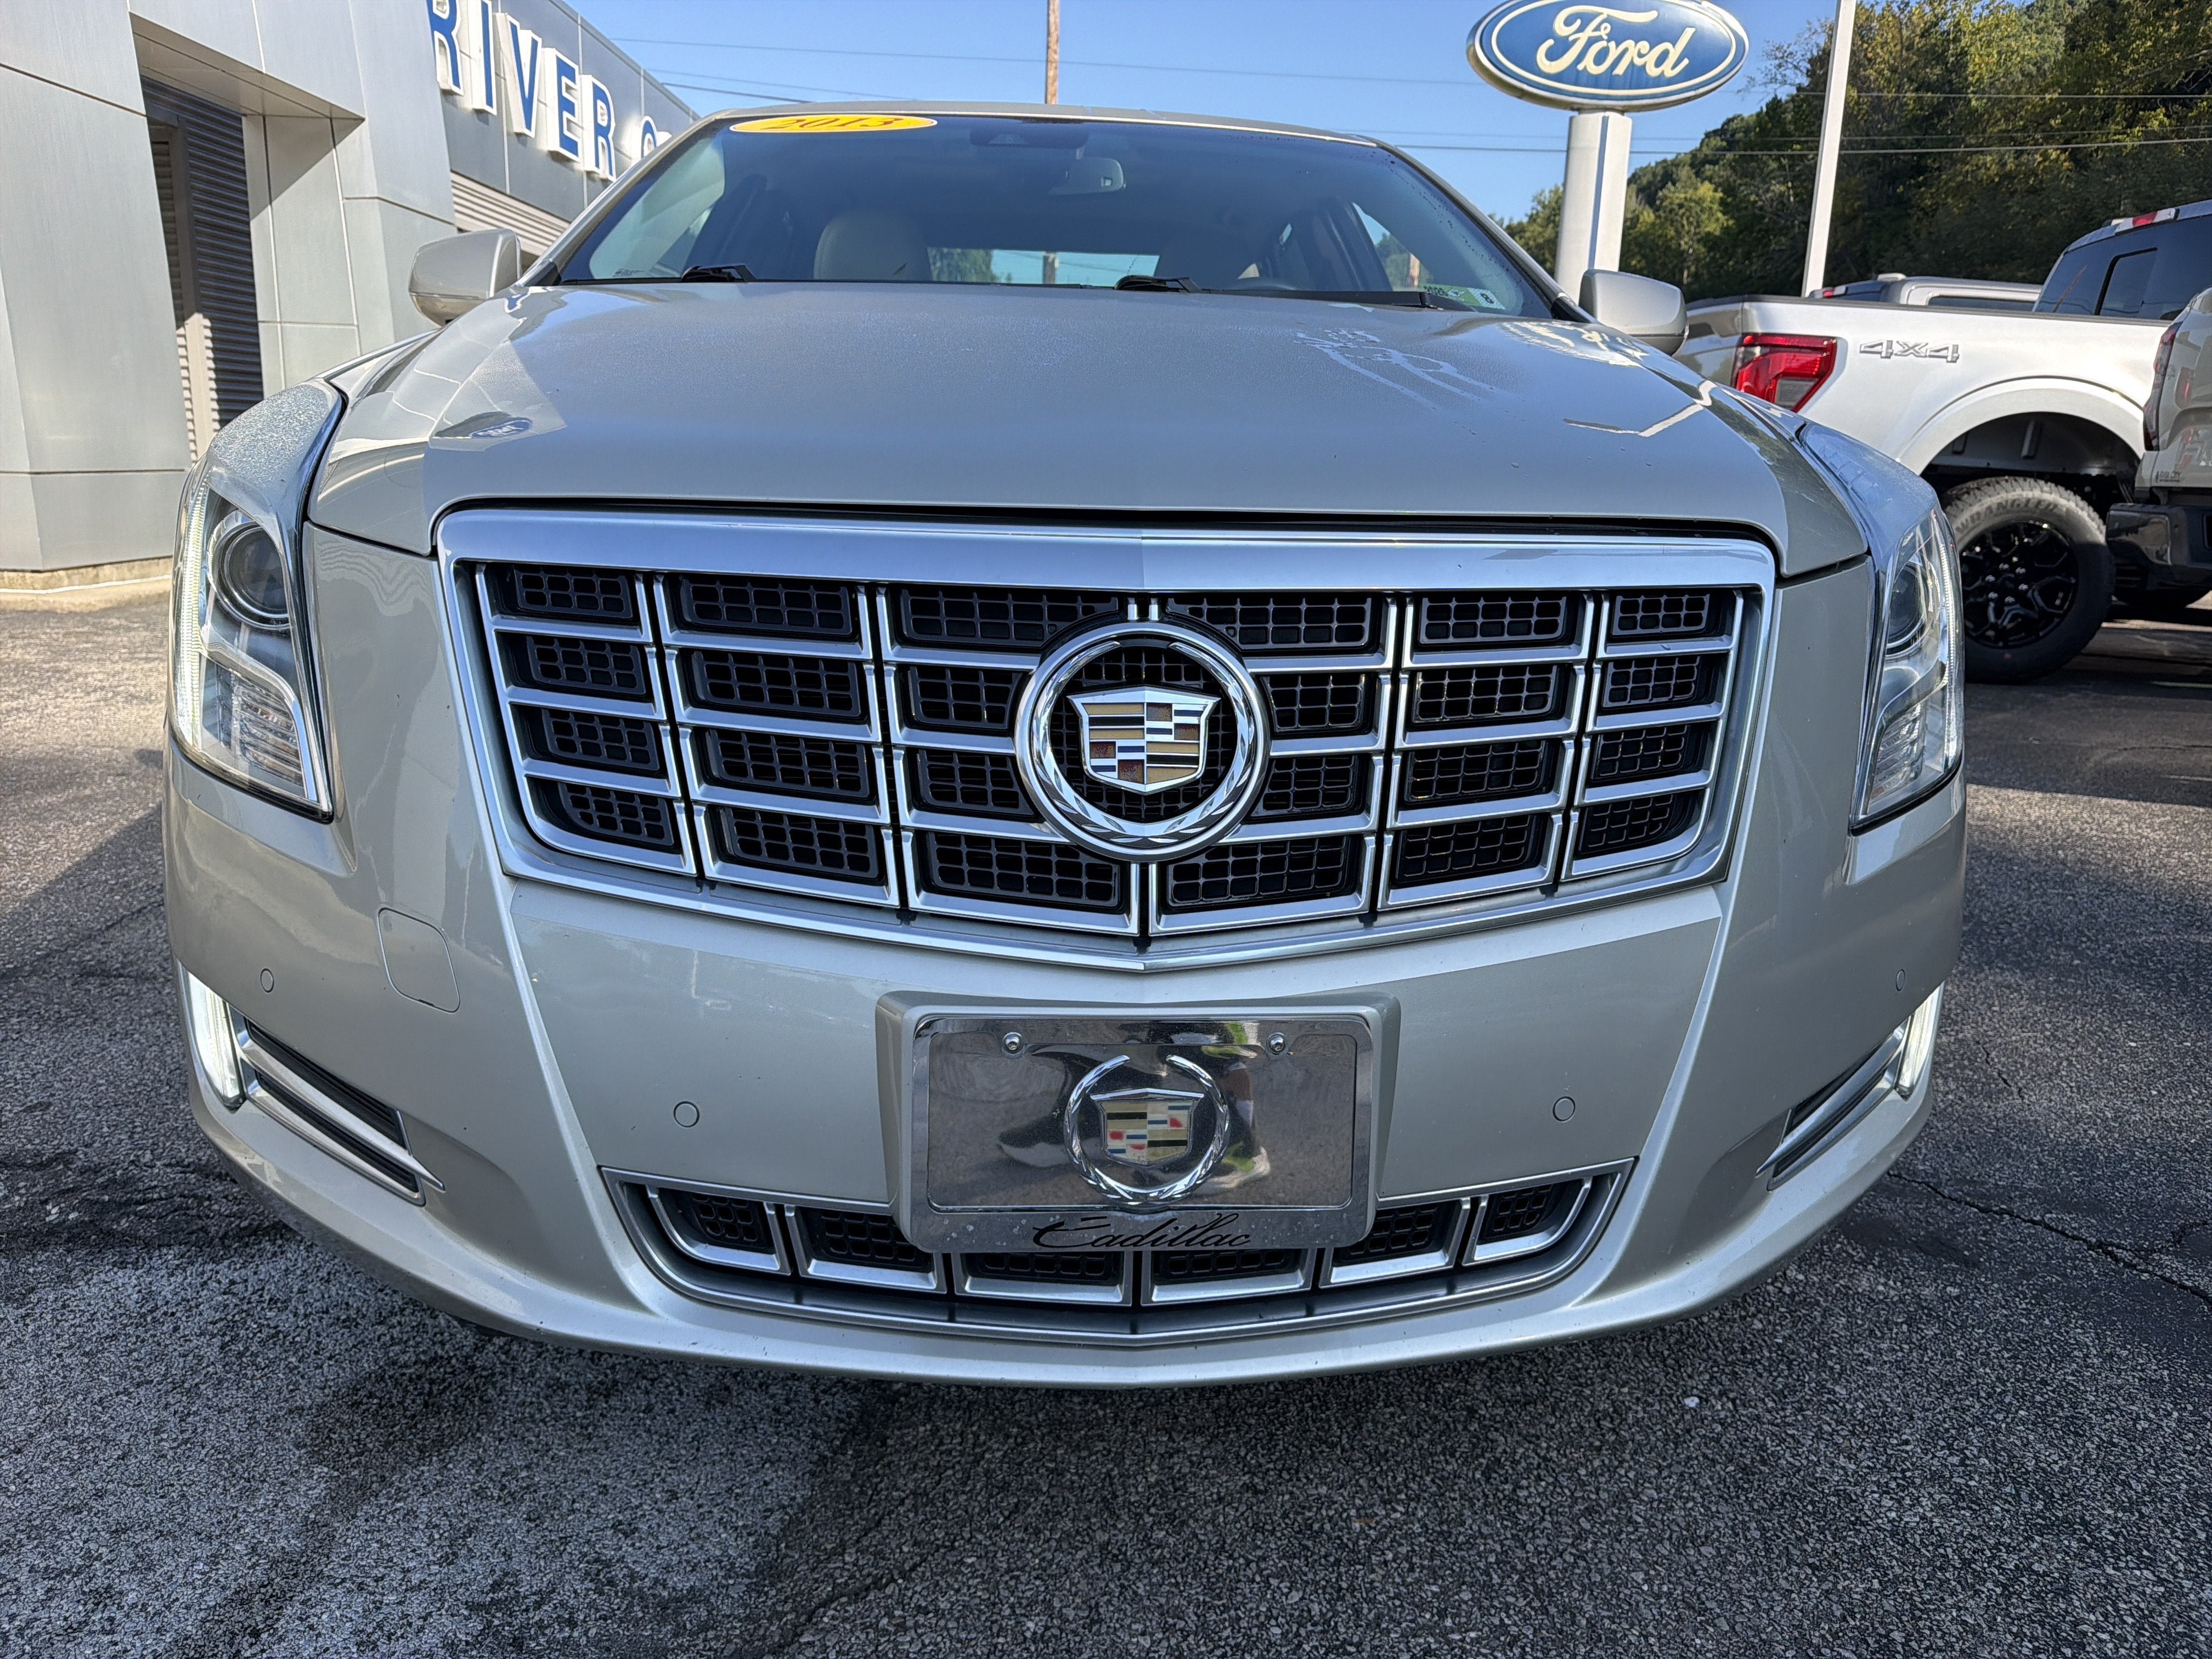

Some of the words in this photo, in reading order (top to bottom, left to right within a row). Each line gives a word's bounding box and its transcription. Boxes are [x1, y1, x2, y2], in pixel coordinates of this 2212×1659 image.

[1536, 5, 1695, 77] Ford
[428, 0, 616, 182] RIVER
[761, 117, 904, 130] 2013
[1032, 1213, 1251, 1248] Cadillac
